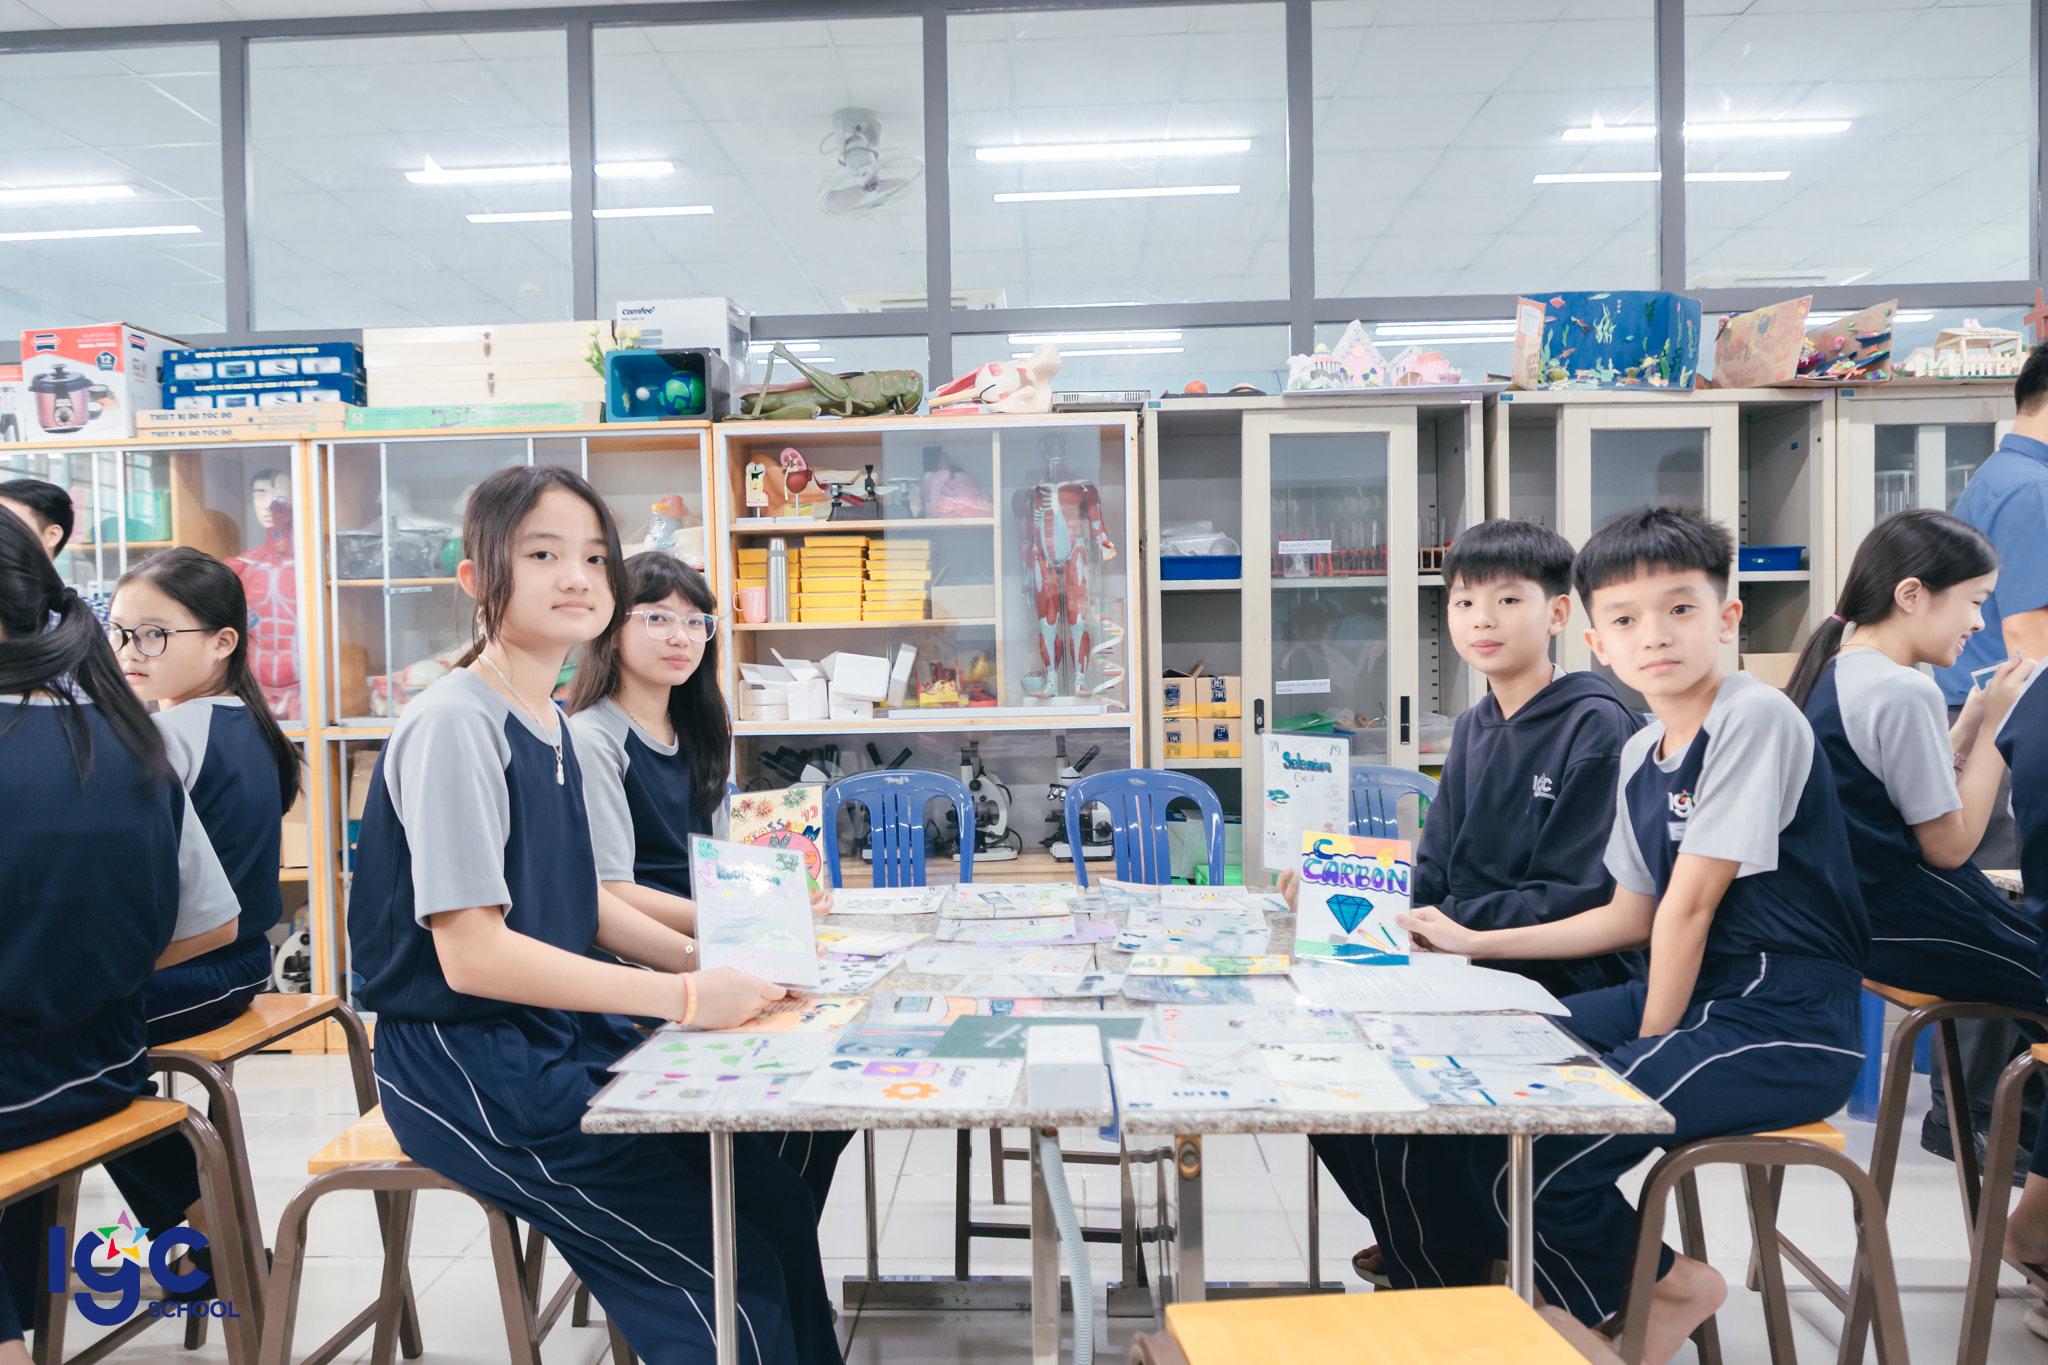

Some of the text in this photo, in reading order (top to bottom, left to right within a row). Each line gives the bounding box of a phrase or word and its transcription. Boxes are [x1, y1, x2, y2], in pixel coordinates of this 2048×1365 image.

[1329, 744, 1342, 756] 79
[1283, 751, 1332, 773] Selenium
[739, 818, 822, 846] OTASSIUM
[1312, 839, 1333, 860] C
[1376, 846, 1395, 868] 6
[1302, 857, 1408, 893] CARBON
[726, 949, 775, 965] Global
